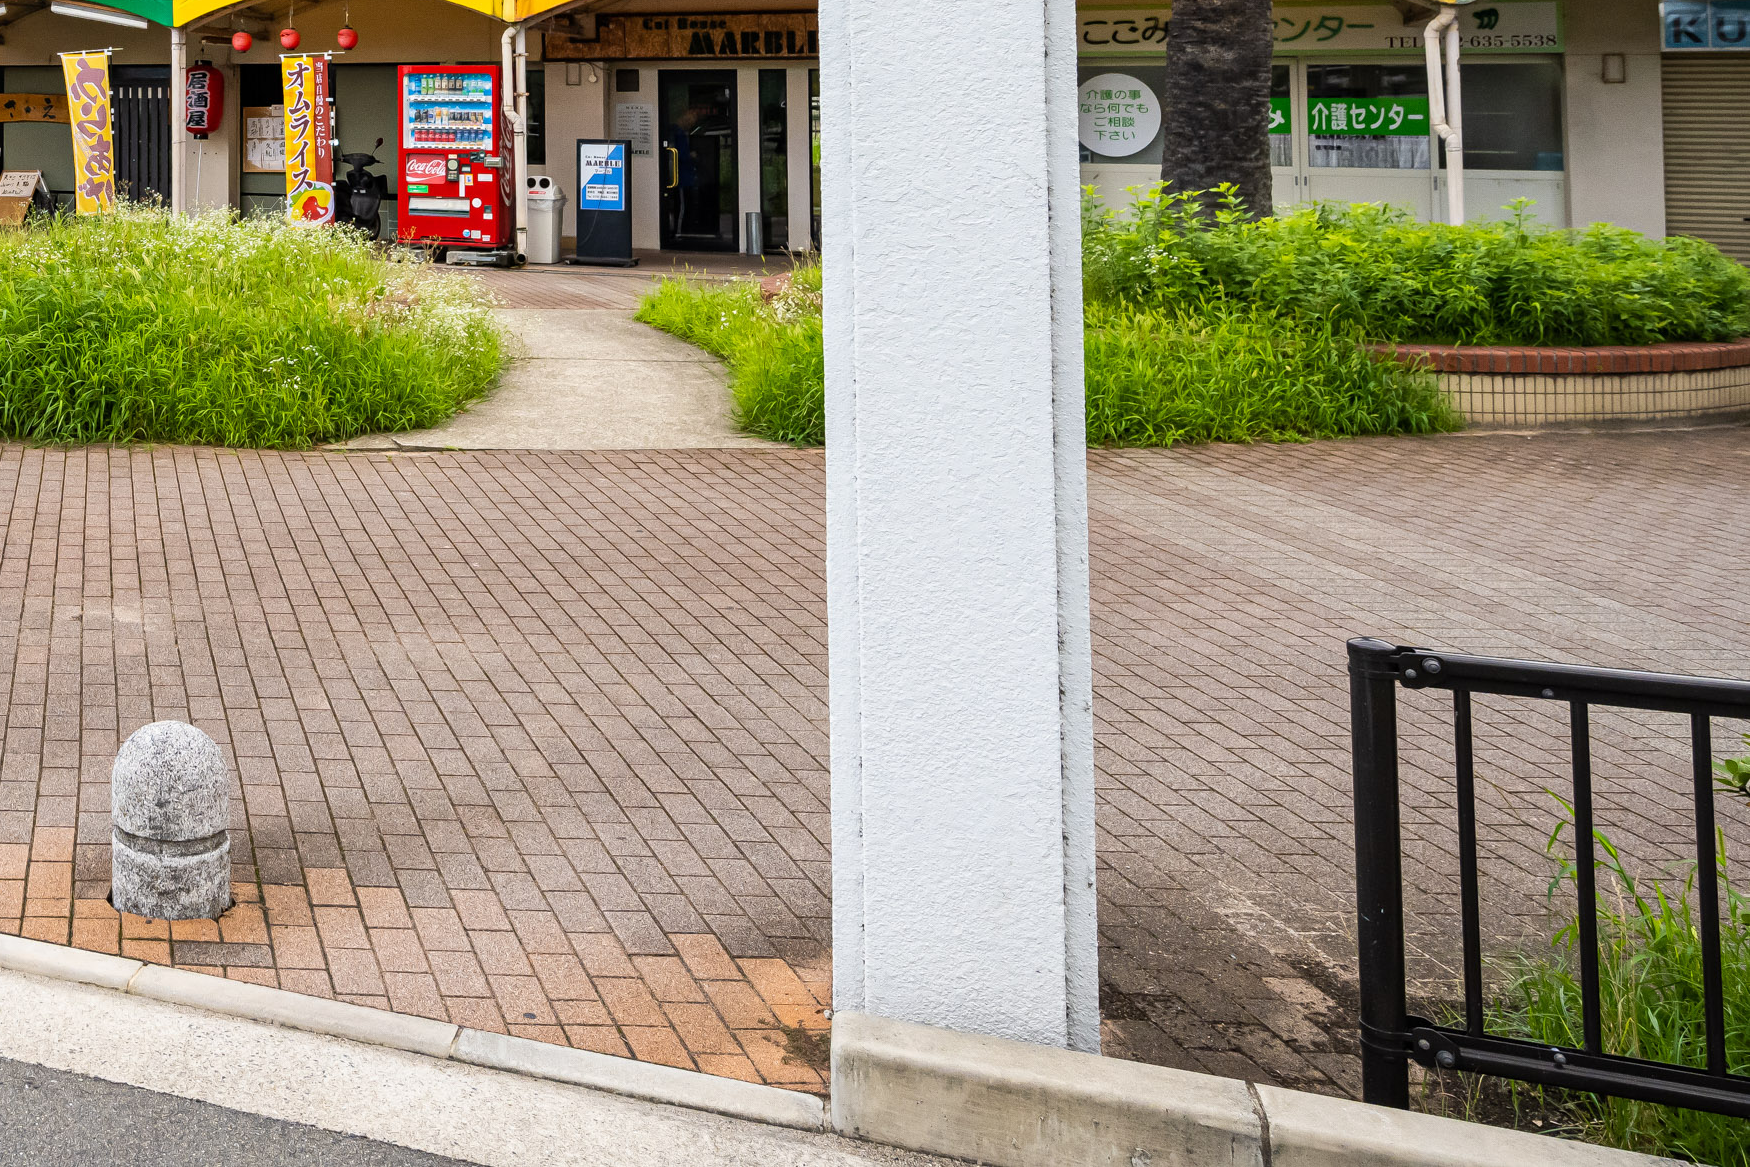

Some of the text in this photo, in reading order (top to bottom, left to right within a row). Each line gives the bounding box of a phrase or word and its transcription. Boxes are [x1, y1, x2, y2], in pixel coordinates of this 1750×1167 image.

[1439, 35, 1557, 48] -635-5538
[186, 71, 210, 128] 居酒屋
[1086, 89, 1141, 101] 介護の事
[1079, 103, 1149, 114] なら何でも
[1094, 116, 1135, 128] ご相談
[1312, 102, 1424, 130] 介護センター
[285, 62, 314, 196] オムライス
[1094, 130, 1136, 141] 下さい
